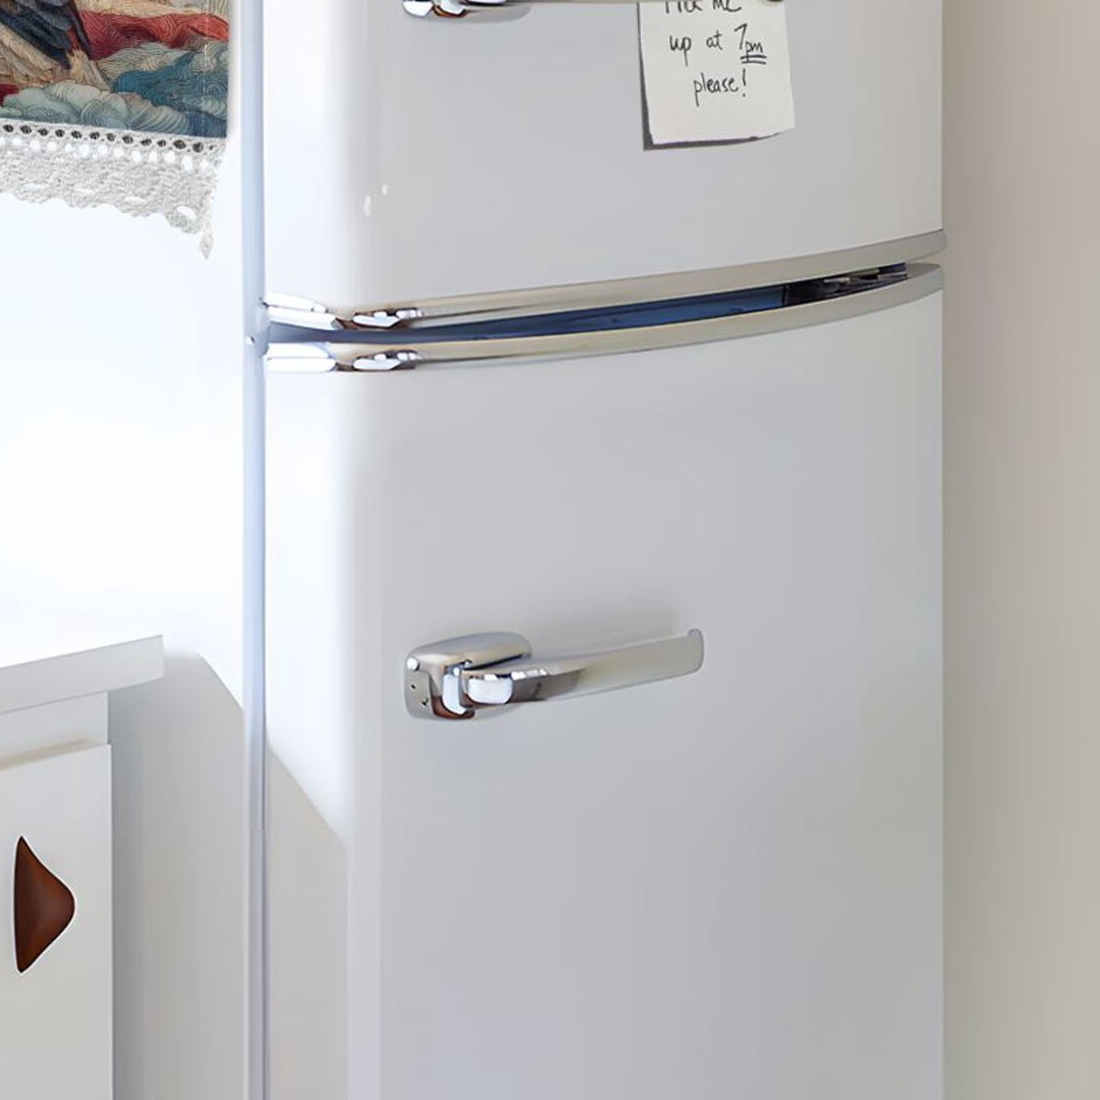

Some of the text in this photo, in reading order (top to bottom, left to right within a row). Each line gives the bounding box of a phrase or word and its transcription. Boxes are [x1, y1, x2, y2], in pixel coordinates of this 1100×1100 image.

[669, 35, 692, 66] up
[706, 30, 723, 51] at
[693, 68, 747, 107] please!
